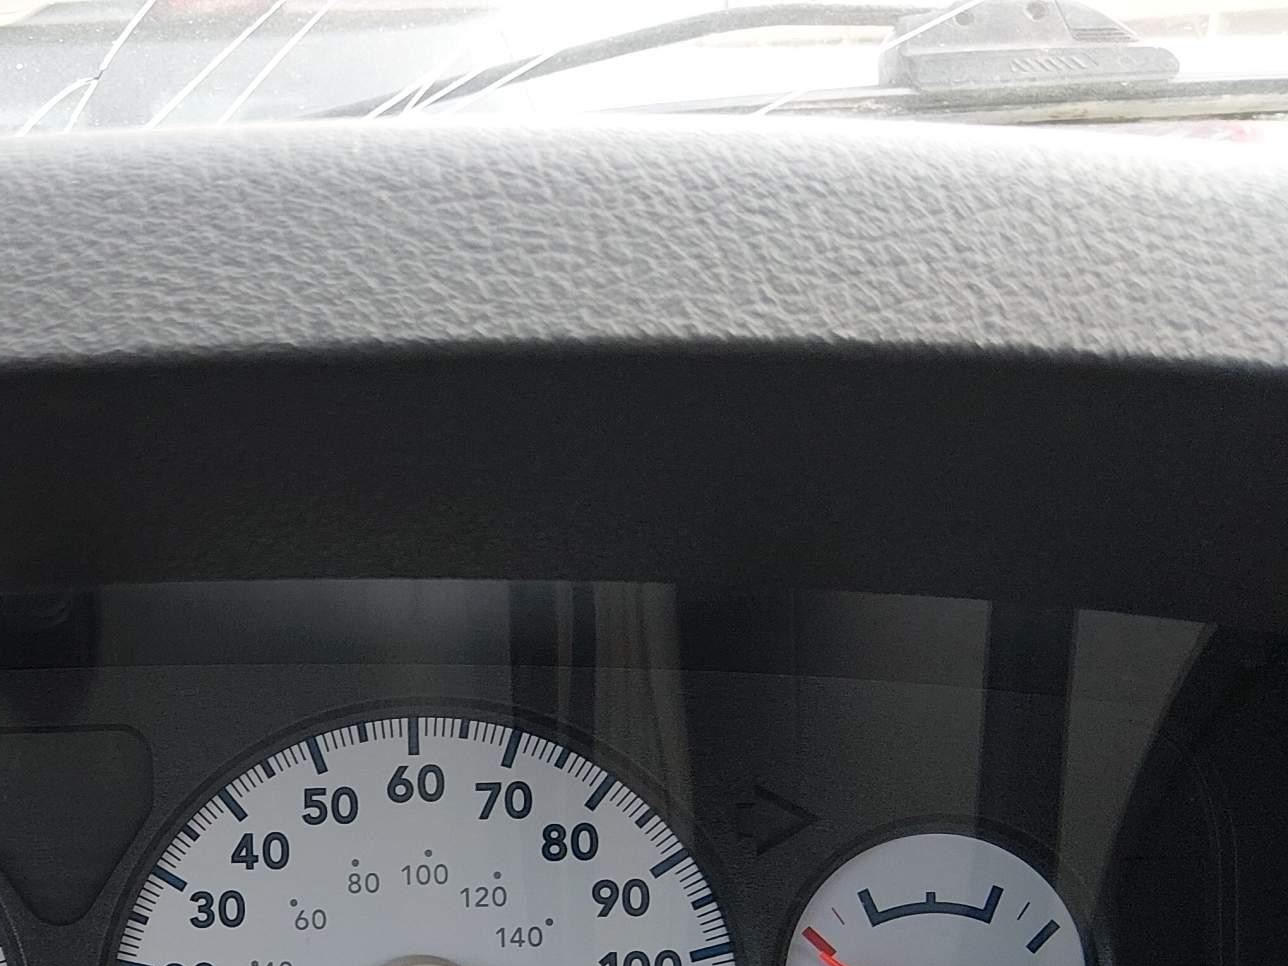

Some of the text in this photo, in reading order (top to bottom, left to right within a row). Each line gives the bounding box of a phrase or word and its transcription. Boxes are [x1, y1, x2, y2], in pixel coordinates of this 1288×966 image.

[386, 763, 445, 804] 60
[475, 780, 533, 820] 70
[301, 786, 359, 826] 50
[230, 831, 290, 871] 40
[541, 822, 599, 862] 80
[347, 872, 380, 894] 80
[401, 863, 449, 886] 100
[189, 889, 246, 929] 30
[460, 886, 507, 908] 120
[591, 878, 650, 918] 90
[294, 908, 327, 931] 60
[495, 926, 543, 948] 140
